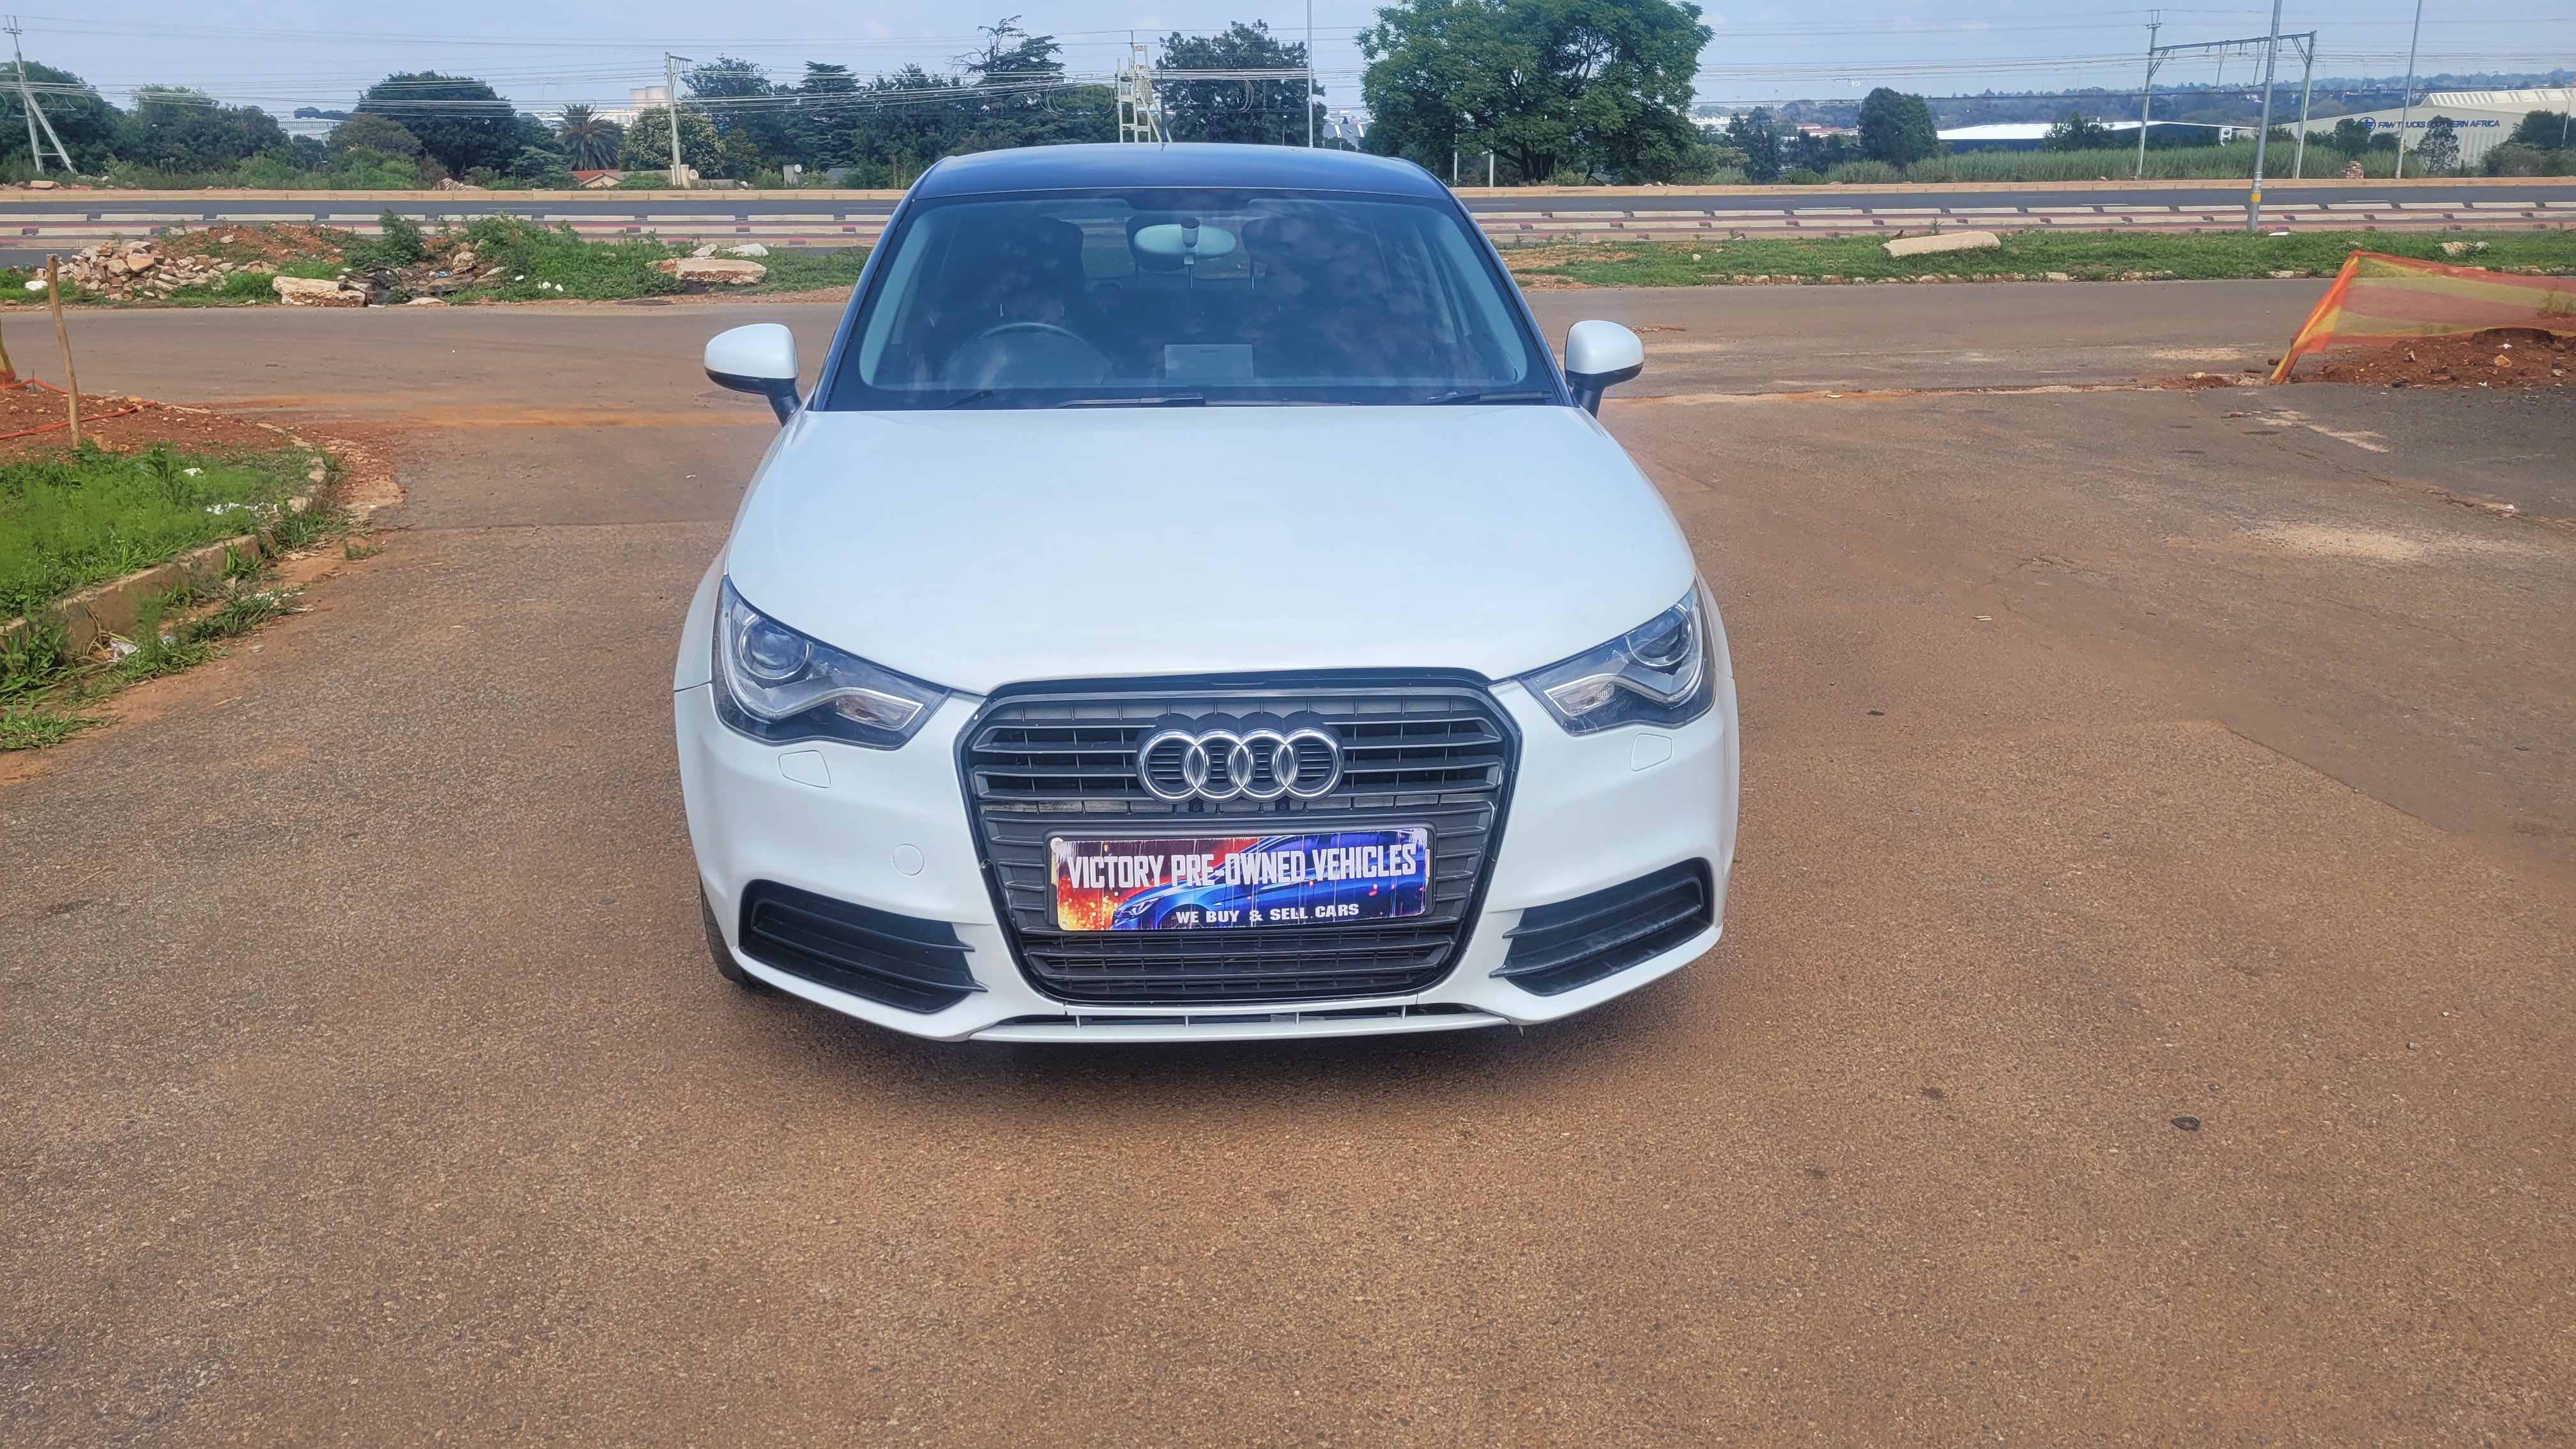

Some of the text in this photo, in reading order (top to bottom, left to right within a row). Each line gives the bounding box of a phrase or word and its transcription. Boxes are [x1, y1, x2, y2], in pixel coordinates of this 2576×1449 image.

[1068, 843, 1416, 889] VICTORY PRE-OWNED VEHICLES
[1176, 903, 1360, 924] WE BUY & SELL CARS
